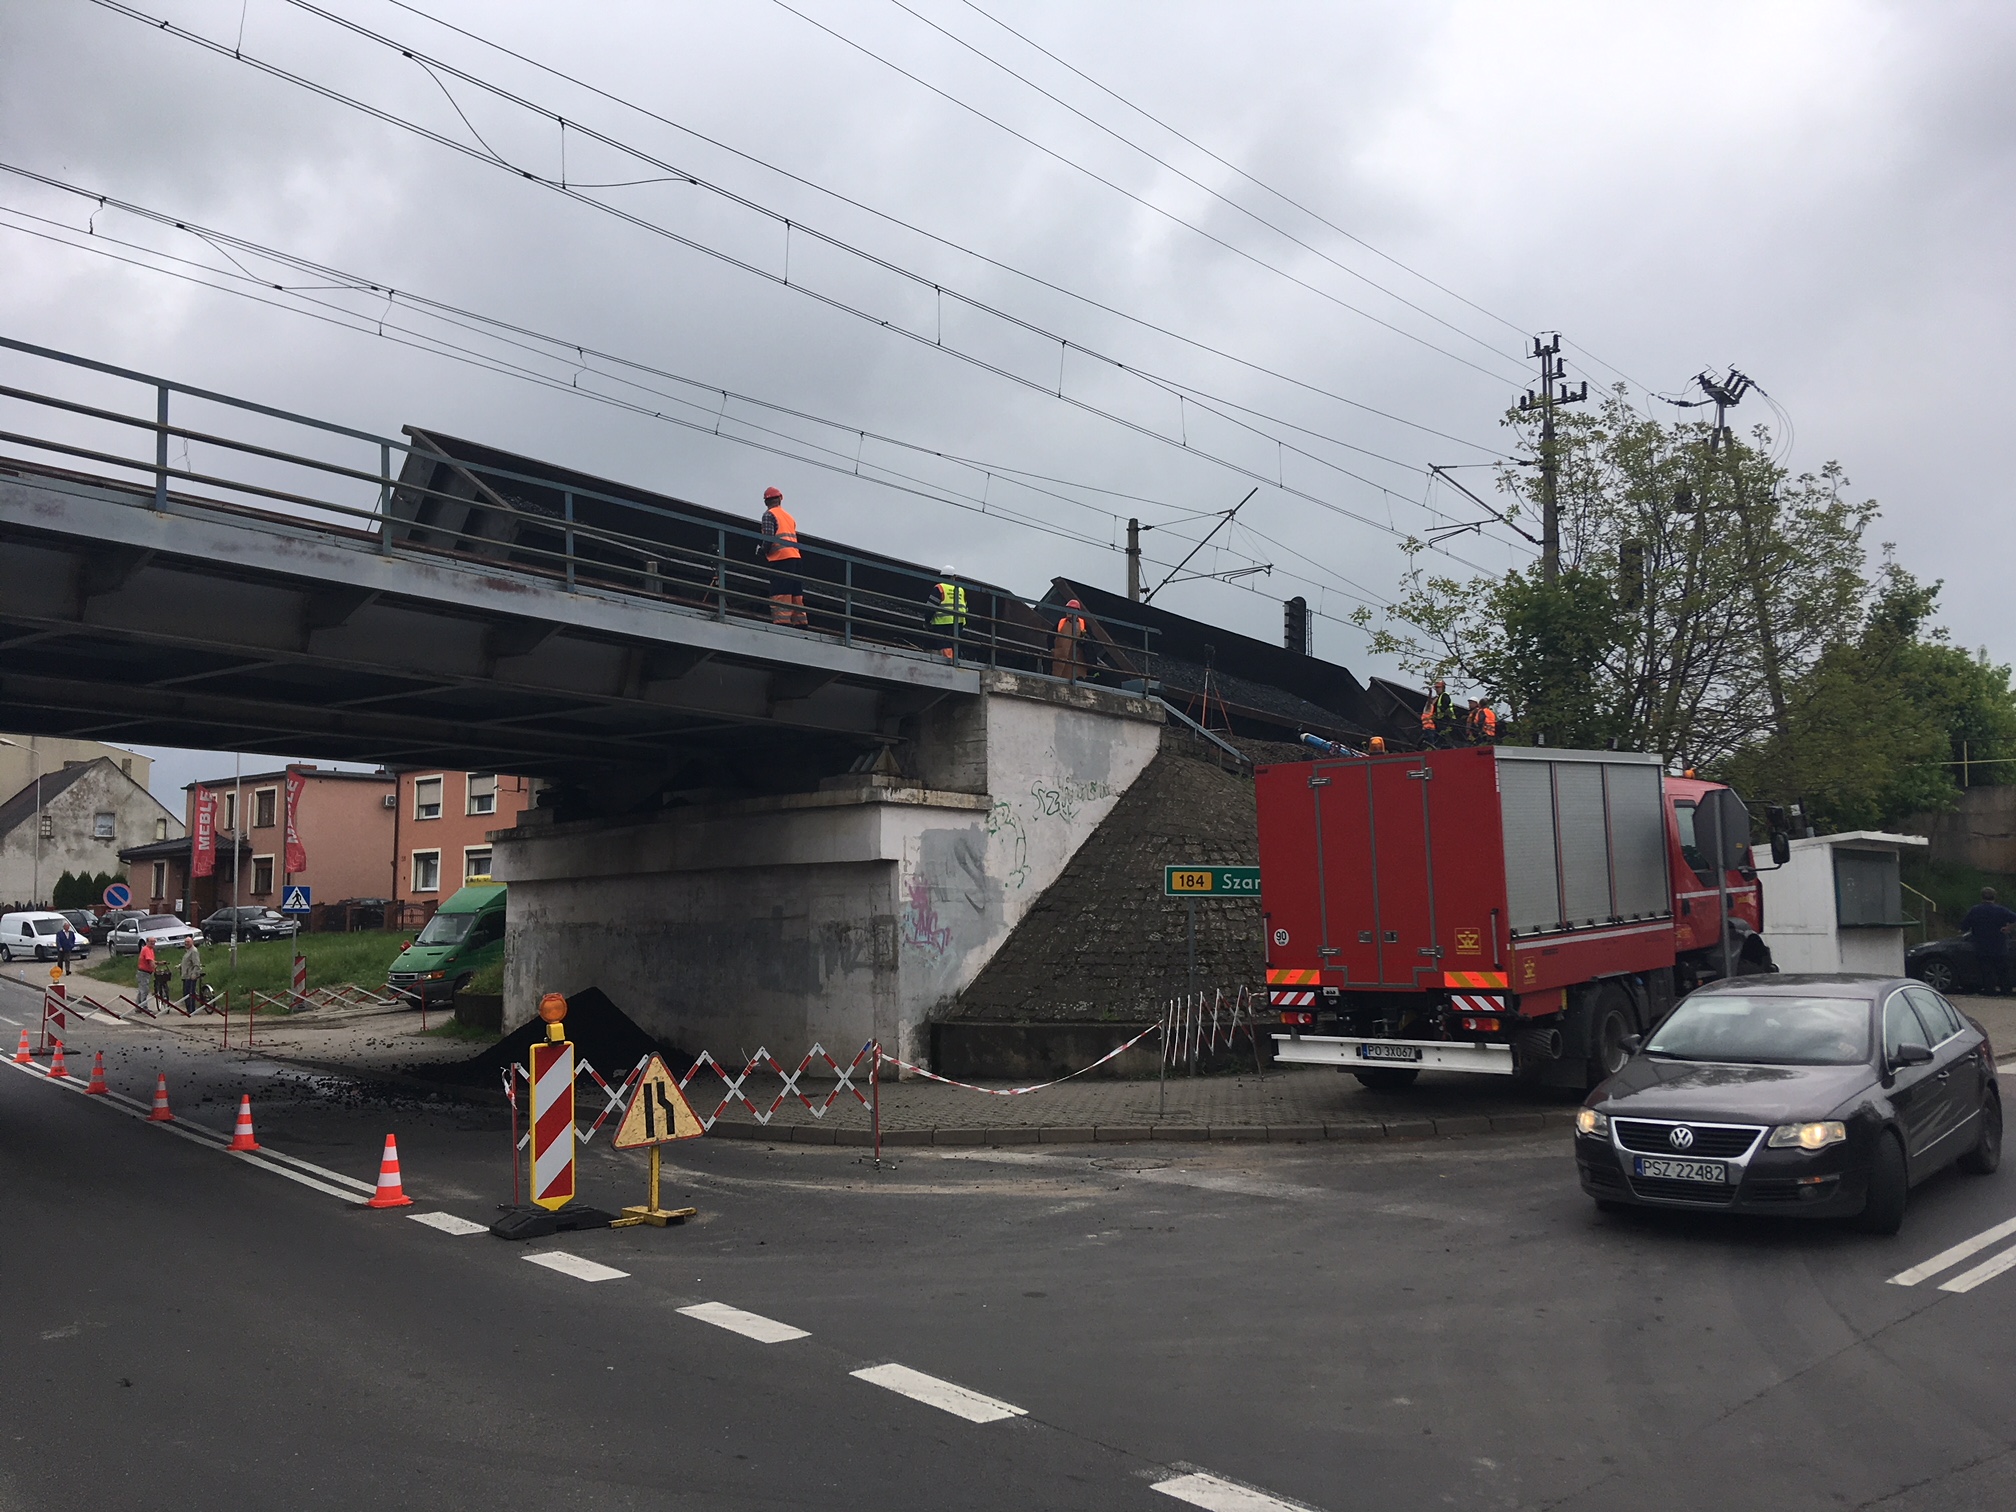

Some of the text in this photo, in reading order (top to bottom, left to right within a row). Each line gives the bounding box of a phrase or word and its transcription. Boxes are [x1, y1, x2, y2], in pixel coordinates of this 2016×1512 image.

[199, 790, 213, 851] MEBLE
[286, 779, 299, 844] MLE
[1179, 874, 1205, 888] 184
[1276, 931, 1287, 941] 90
[1368, 1045, 1382, 1056] PO
[1670, 1127, 1693, 1149] VW
[1643, 1160, 1725, 1182] PSZ 22482
